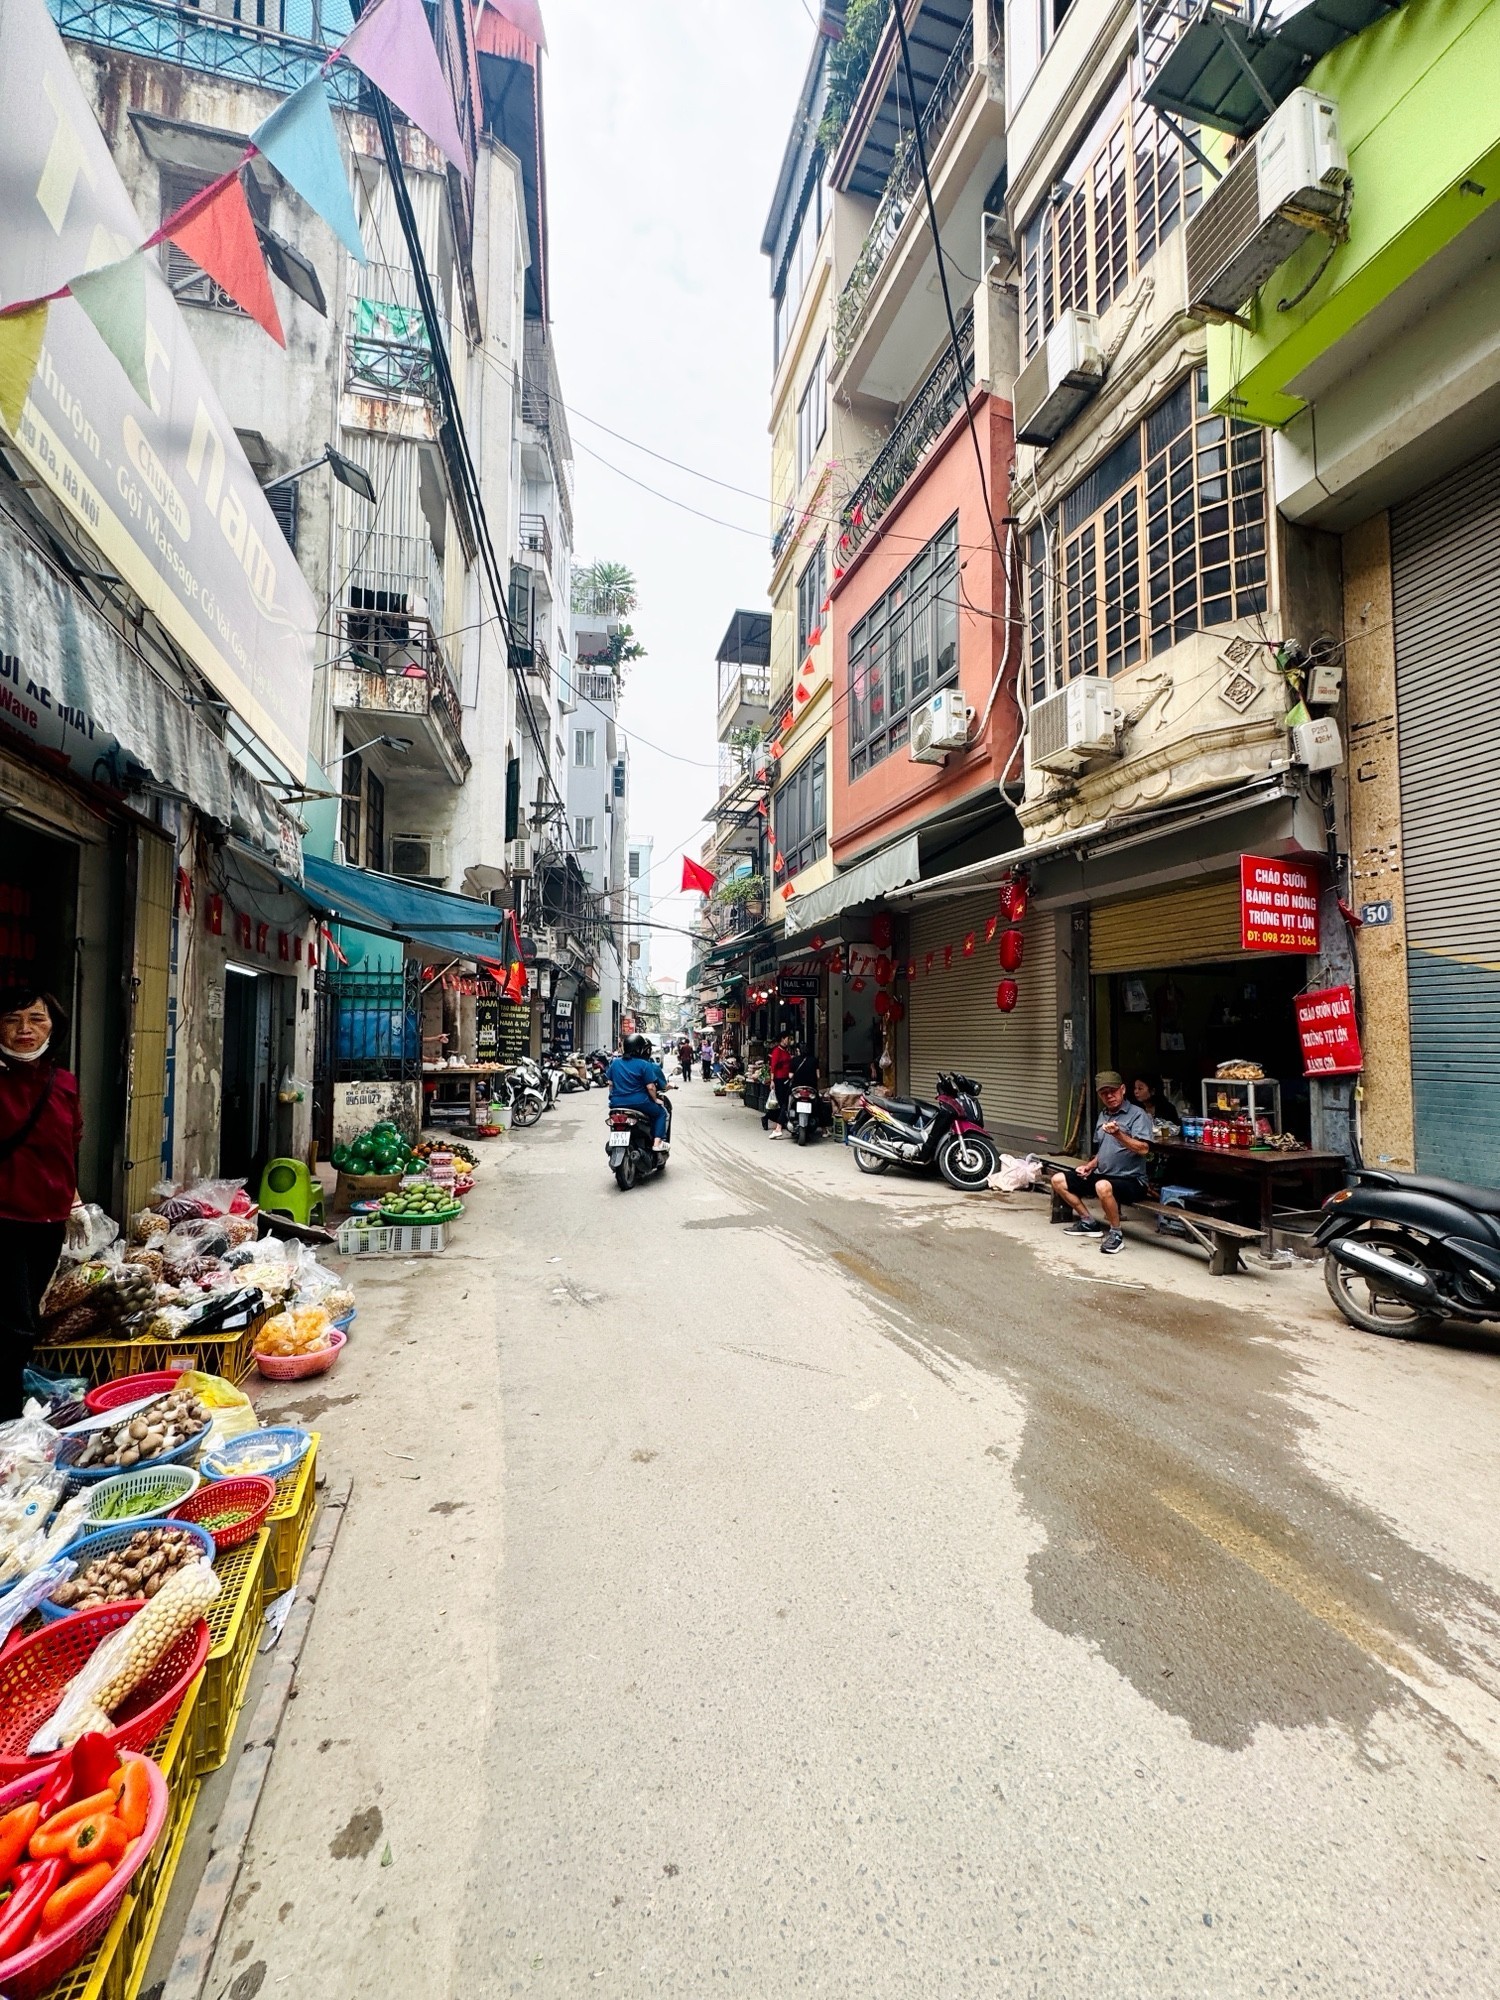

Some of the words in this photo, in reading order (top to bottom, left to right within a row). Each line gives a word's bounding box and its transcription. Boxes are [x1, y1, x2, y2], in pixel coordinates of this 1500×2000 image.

[138, 439, 183, 527] Chuyên
[62, 463, 79, 502] Hà
[80, 486, 101, 528] Nội
[117, 465, 143, 520] Gội
[145, 504, 198, 598] Massage
[216, 607, 230, 643] Vai
[1255, 868, 1280, 885] CHÁO
[1282, 871, 1307, 889] SƯỜN
[1245, 887, 1271, 905] BÁNH
[1274, 890, 1289, 907] GIÒ
[1291, 892, 1317, 911] NÓNG
[1249, 909, 1280, 927] TRỨNG
[1281, 913, 1296, 931] VỊT
[1297, 914, 1315, 932] LỘN
[1366, 904, 1388, 923] 50
[1074, 919, 1085, 931] 52
[1247, 930, 1260, 942] ĐT:
[1262, 932, 1278, 944] 098
[1280, 933, 1295, 945] 223
[1297, 935, 1317, 947] 1064
[783, 980, 800, 988] NAIL
